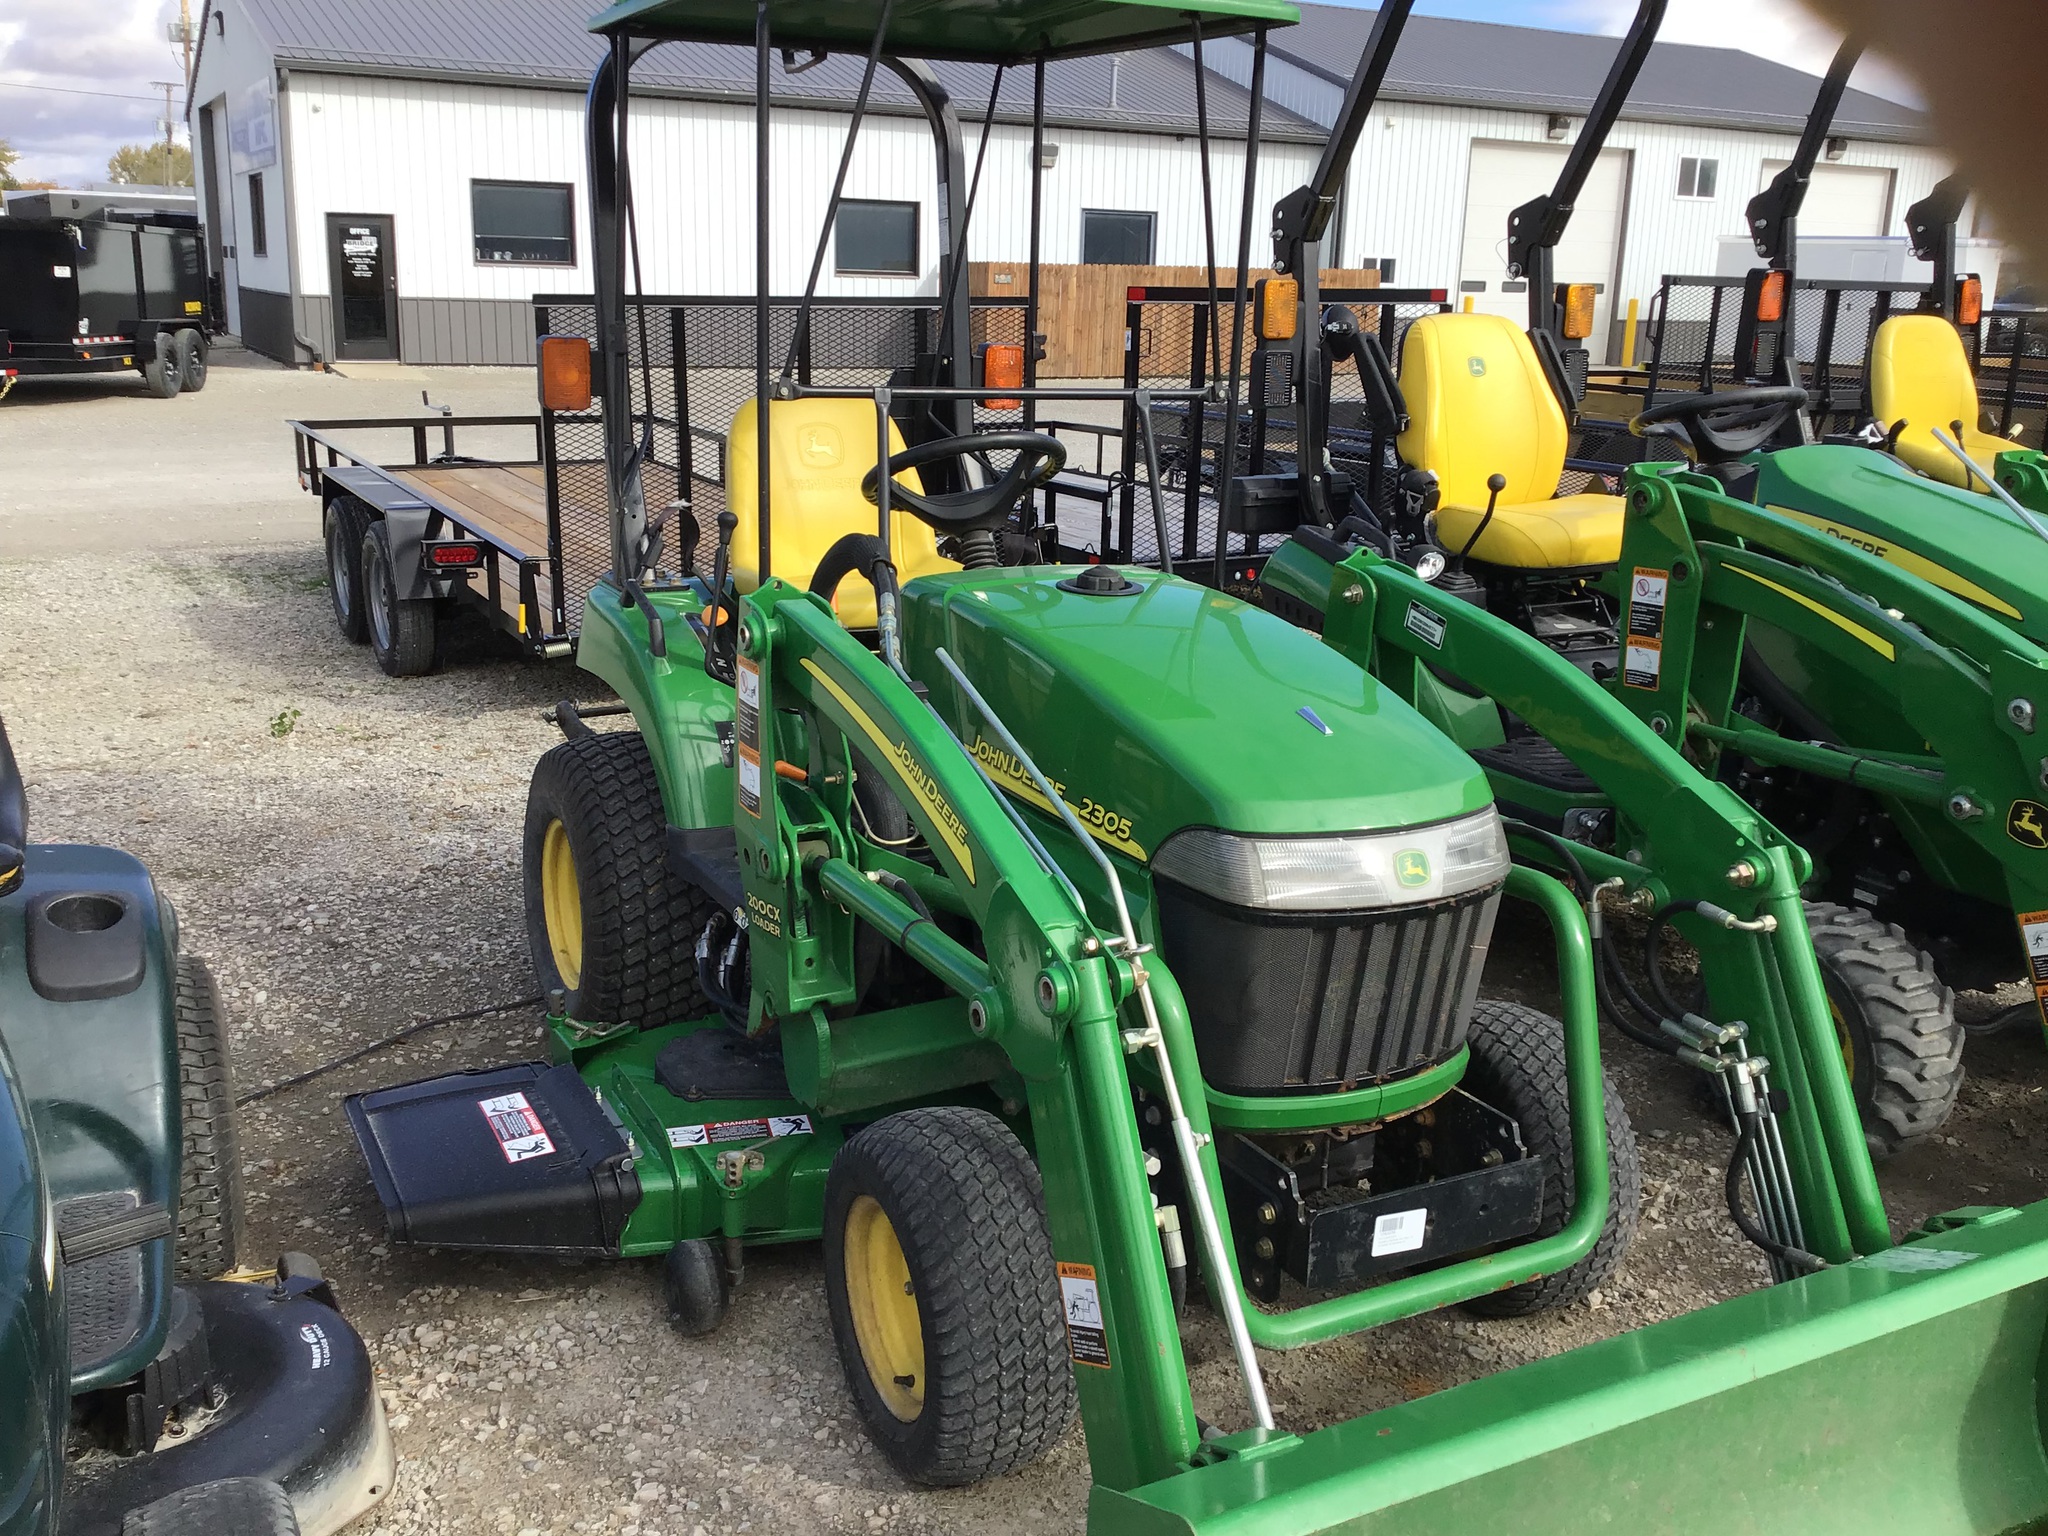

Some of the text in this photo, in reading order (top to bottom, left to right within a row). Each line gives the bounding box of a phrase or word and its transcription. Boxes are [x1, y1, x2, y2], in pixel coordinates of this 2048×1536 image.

[349, 227, 370, 235] OFFICE
[1079, 797, 1133, 840] 2305
[747, 891, 781, 924] 200CX
[751, 911, 781, 938] LOADER
[723, 1119, 760, 1127] DANGER
[1067, 1266, 1092, 1277] WARNING
[301, 1326, 321, 1369] HEAVY DUTY
[311, 1323, 331, 1367] 12 GAUGE DECK
